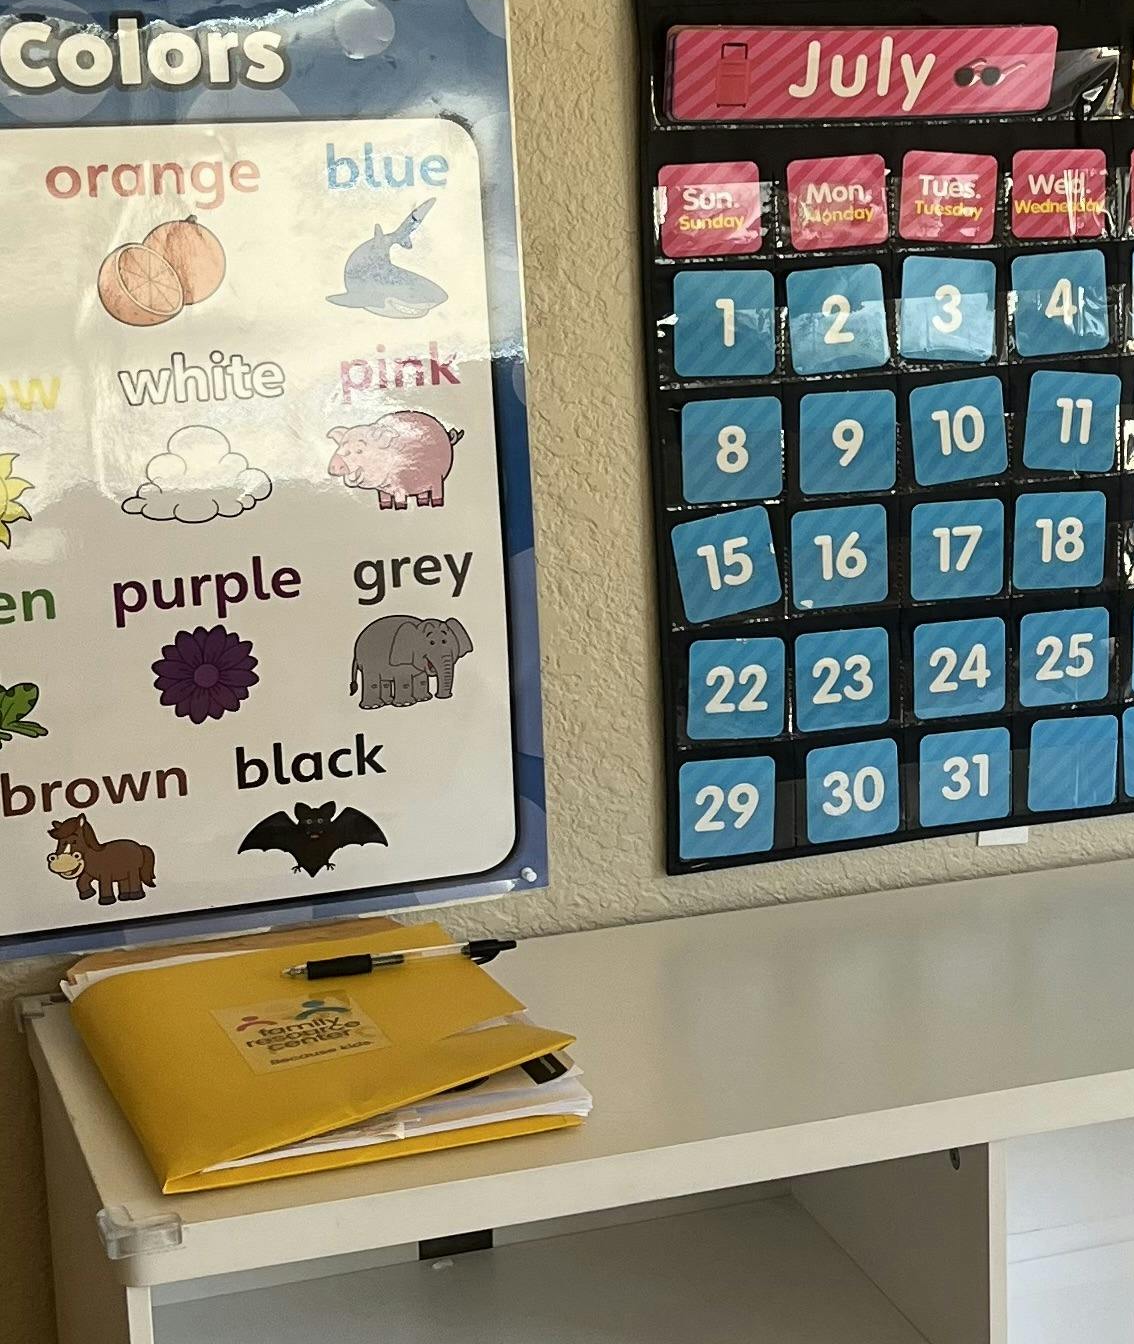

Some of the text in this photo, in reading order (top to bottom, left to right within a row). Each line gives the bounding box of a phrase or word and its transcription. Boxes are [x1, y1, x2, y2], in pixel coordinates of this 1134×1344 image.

[0, 12, 289, 92] Colors
[788, 35, 936, 112] July
[45, 143, 450, 209] orange blue
[682, 188, 739, 210] Sun.
[805, 182, 873, 204] Mon.
[918, 174, 981, 199] Tues.
[1028, 169, 1092, 195] Wed.
[678, 214, 744, 231] Sunday
[914, 199, 982, 221] Tuesday
[715, 299, 734, 347] 1
[821, 294, 853, 343] 2
[932, 284, 963, 333] 3
[1046, 278, 1077, 321] 4
[118, 351, 285, 406] white
[340, 341, 461, 405] pink
[715, 425, 748, 473] 8
[831, 418, 863, 467] 9
[931, 407, 986, 456] 10
[1056, 398, 1092, 445] 11
[112, 556, 301, 628] purple
[353, 552, 473, 605] grey
[697, 536, 753, 591] 15
[814, 532, 867, 580] 16
[932, 526, 982, 573] 17
[1035, 517, 1085, 563] 18
[704, 664, 768, 713] 22
[811, 655, 873, 704] 23
[928, 643, 989, 692] 24
[1035, 633, 1093, 680] 25
[0, 733, 387, 816] brown black
[694, 754, 989, 831] 29 30 31
[258, 1017, 340, 1036] family
[269, 1030, 350, 1051] center
